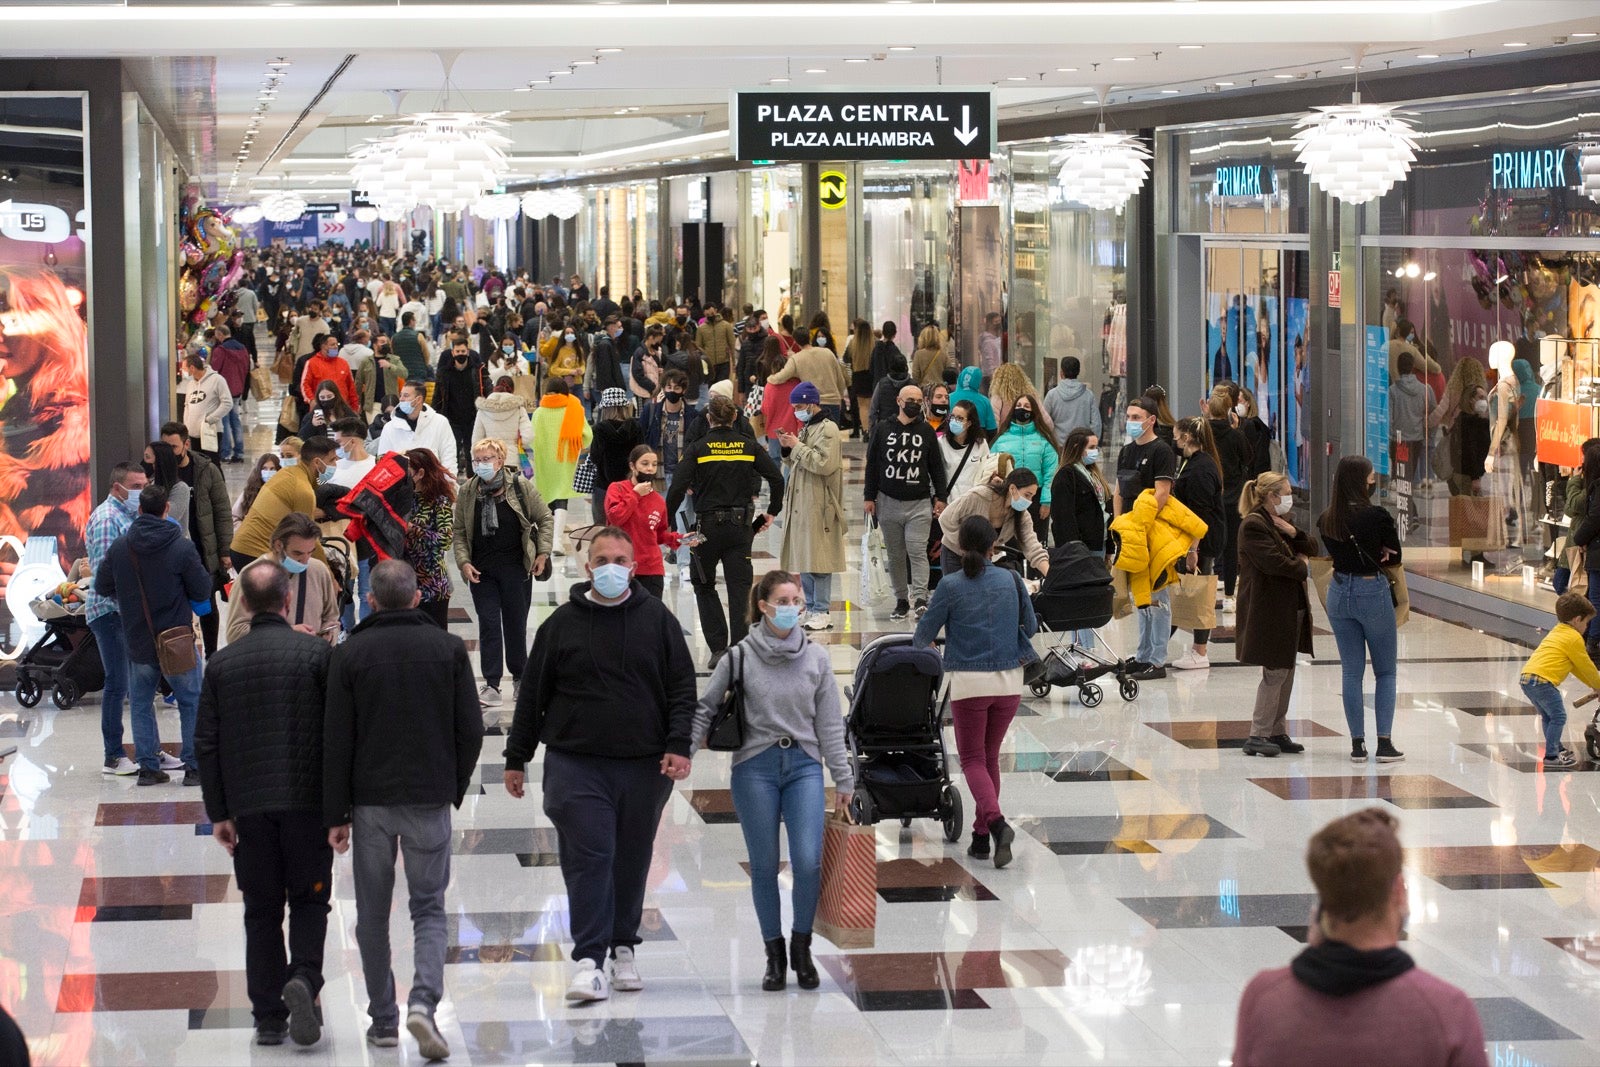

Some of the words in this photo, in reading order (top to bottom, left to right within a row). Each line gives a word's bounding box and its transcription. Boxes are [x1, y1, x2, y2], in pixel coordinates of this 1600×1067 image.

[757, 104, 833, 122] PLAZA
[841, 104, 949, 122] CENTRAL
[771, 132, 829, 147] PLAZA
[833, 132, 934, 146] ALHAMBRA
[1492, 148, 1566, 190] PRIMARK
[1216, 165, 1262, 196] PRIMARK
[707, 441, 745, 449] VIGILANT
